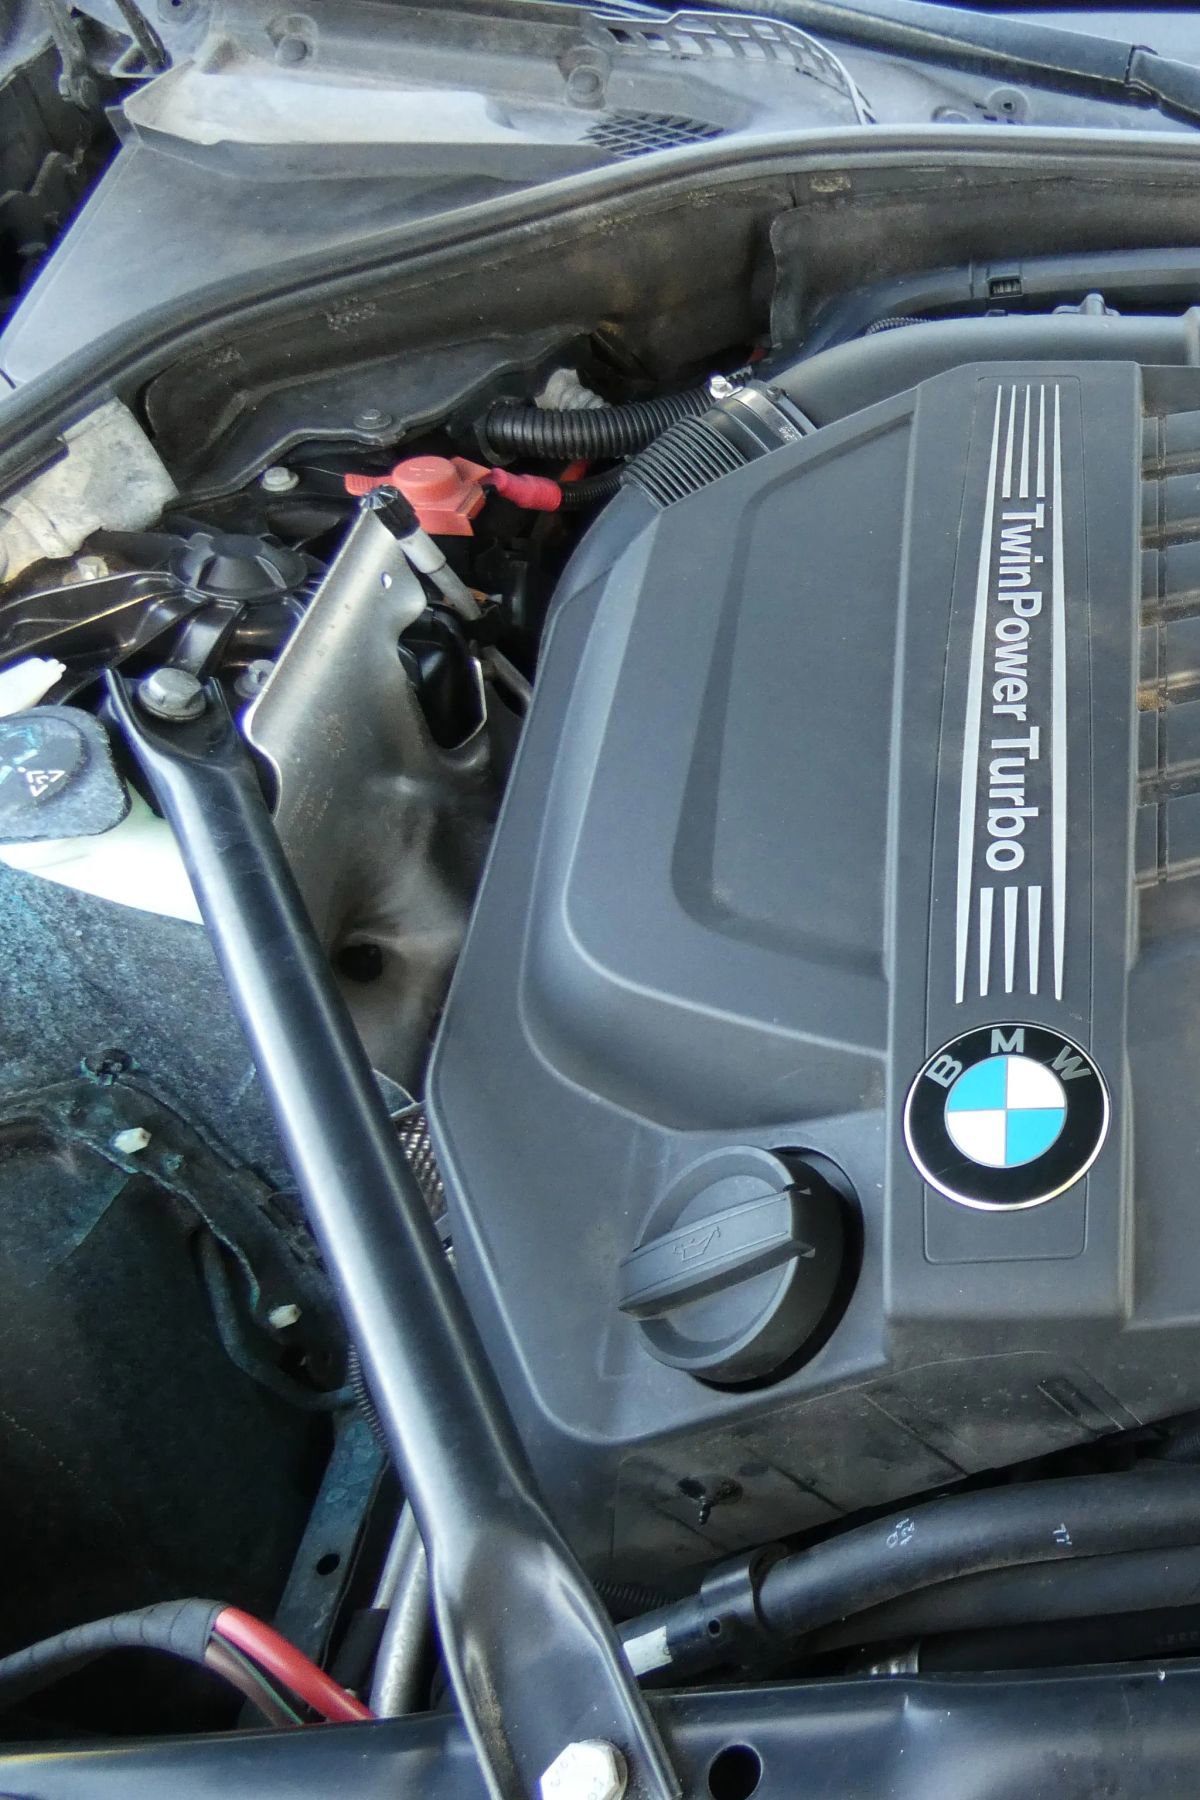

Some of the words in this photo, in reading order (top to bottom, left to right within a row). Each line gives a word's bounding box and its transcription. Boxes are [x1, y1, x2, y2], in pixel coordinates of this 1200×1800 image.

[992, 503, 1045, 721] TwinPower
[985, 726, 1040, 872] Turbo
[925, 1028, 1092, 1088] BMW
